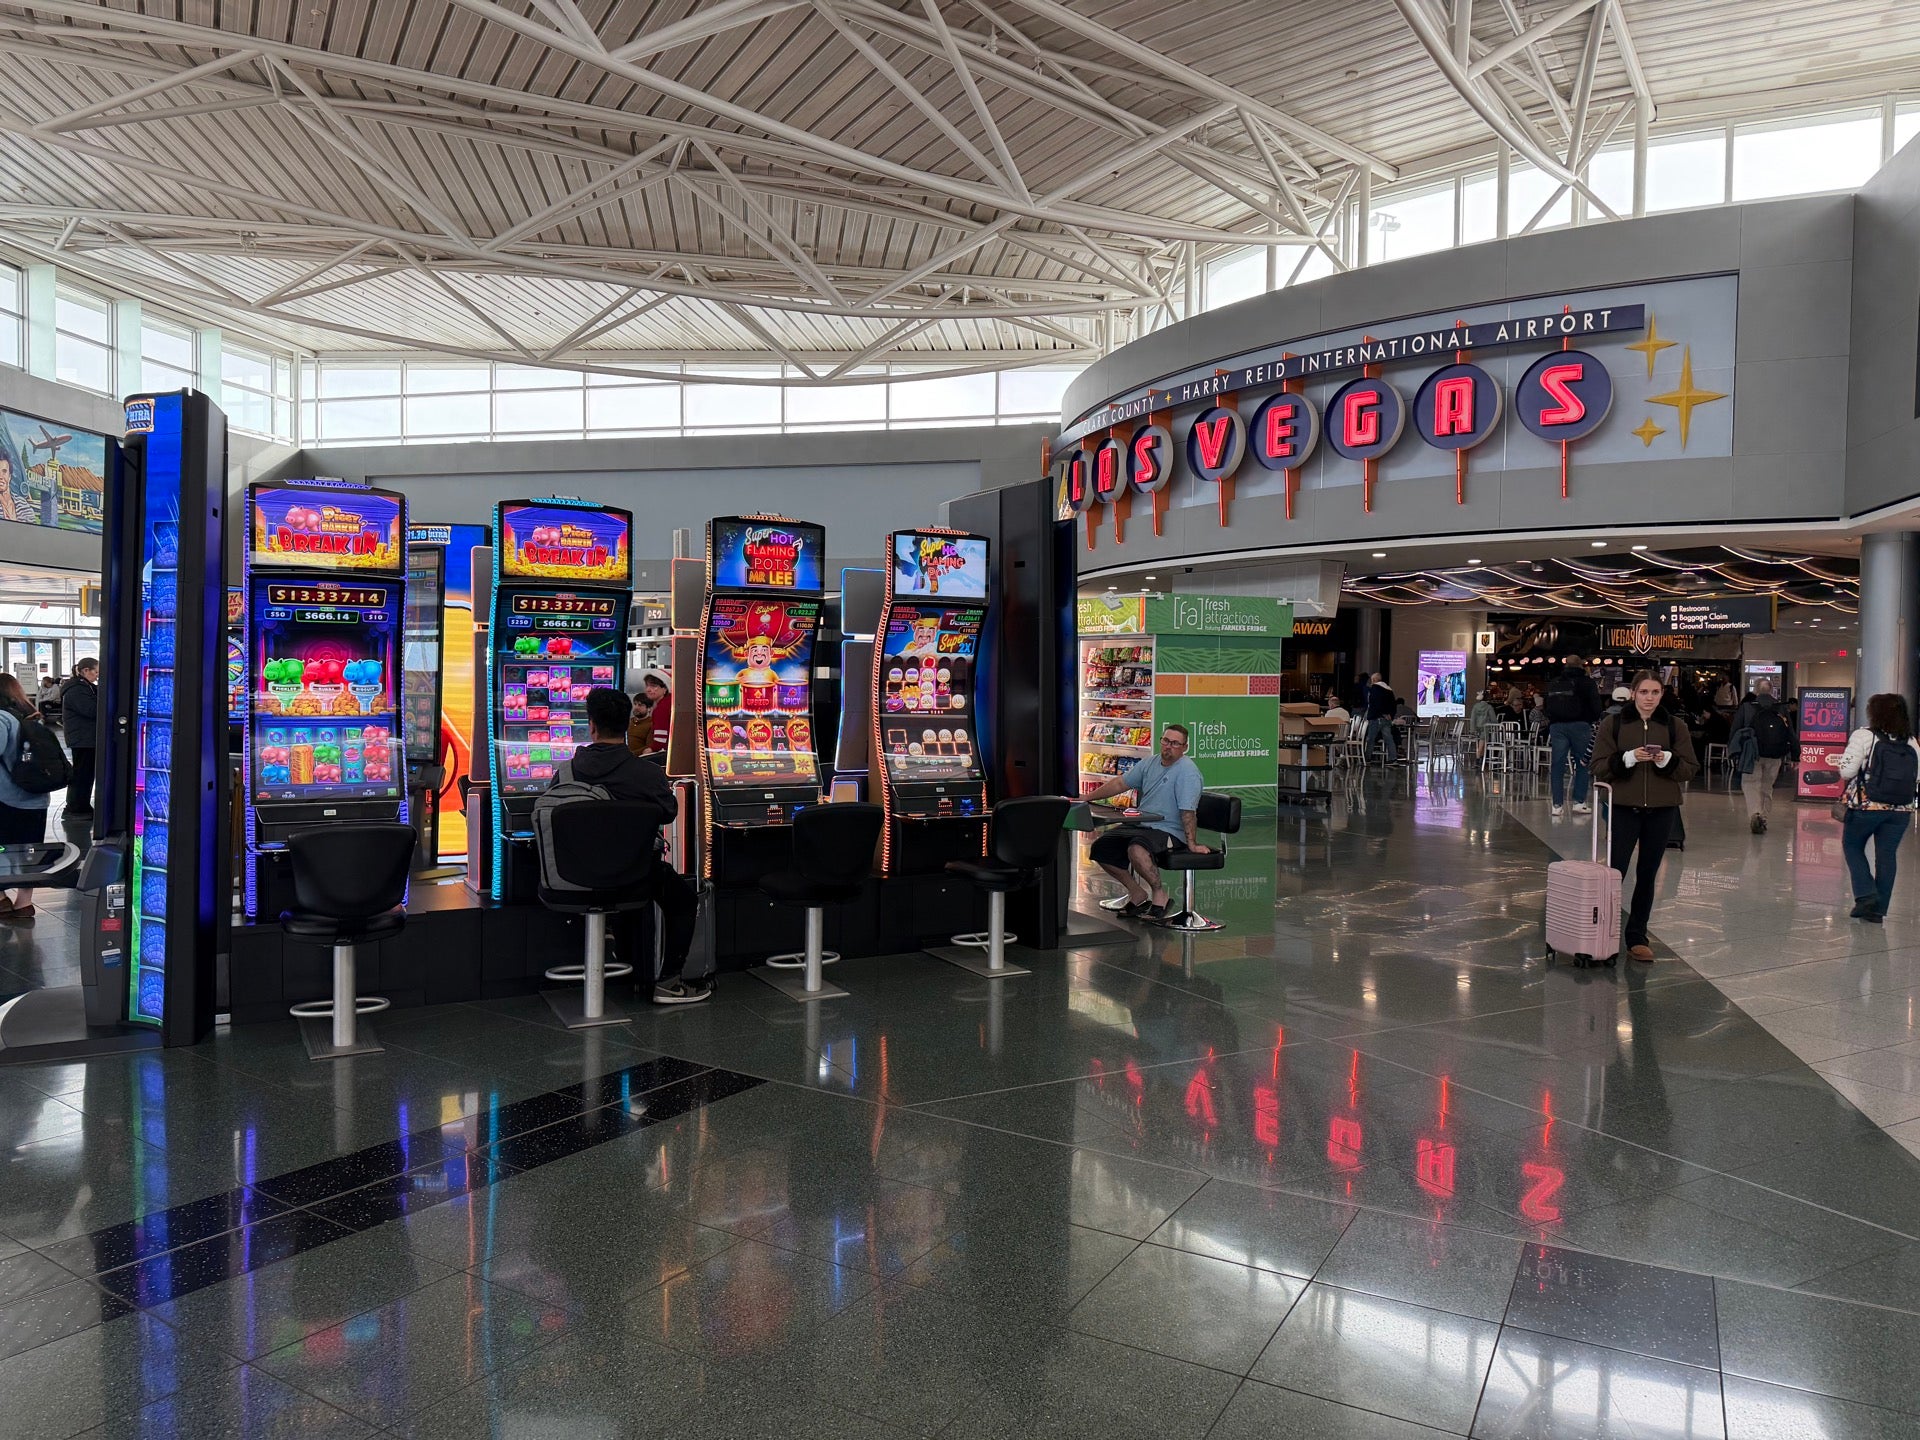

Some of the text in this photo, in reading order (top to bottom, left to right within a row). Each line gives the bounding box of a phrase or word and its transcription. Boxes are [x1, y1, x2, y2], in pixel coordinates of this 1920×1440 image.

[1082, 310, 1612, 434] CLARK COUNTY HARRY REID INTERNATIONAL AIRPORT
[1072, 363, 1586, 502] LAS VEGAS
[277, 526, 380, 556] BREAK IN
[744, 527, 794, 547] Super HOT
[523, 541, 609, 567] BREAK IN
[747, 544, 795, 557] FLAMING
[920, 538, 946, 559] Super
[754, 558, 790, 571] POTS
[921, 556, 965, 569] FLAMING
[749, 570, 793, 585] MR LEE
[1204, 598, 1230, 611] fresh
[1678, 605, 1710, 613] Restrooms
[304, 612, 350, 621] $666.14
[1078, 612, 1114, 626] ttractions
[1204, 610, 1260, 624] attractions
[1678, 613, 1729, 622] Baggage Claim
[542, 620, 582, 628] $666.14
[1704, 622, 1751, 631] Transportation
[940, 633, 968, 652] Super
[1610, 628, 1635, 647] VEGAS
[958, 643, 971, 653] 2X
[1673, 639, 1694, 650] GRILL
[712, 697, 735, 706] YUMMY
[783, 697, 801, 706] SPICY
[1803, 708, 1845, 727] 50%
[1198, 721, 1227, 735] fresh
[1198, 735, 1262, 750] attractions
[1217, 750, 1245, 758] FARMER'S
[1246, 749, 1270, 757] FRIDGE
[1802, 747, 1825, 755] SAVE
[1802, 756, 1817, 764] $30
